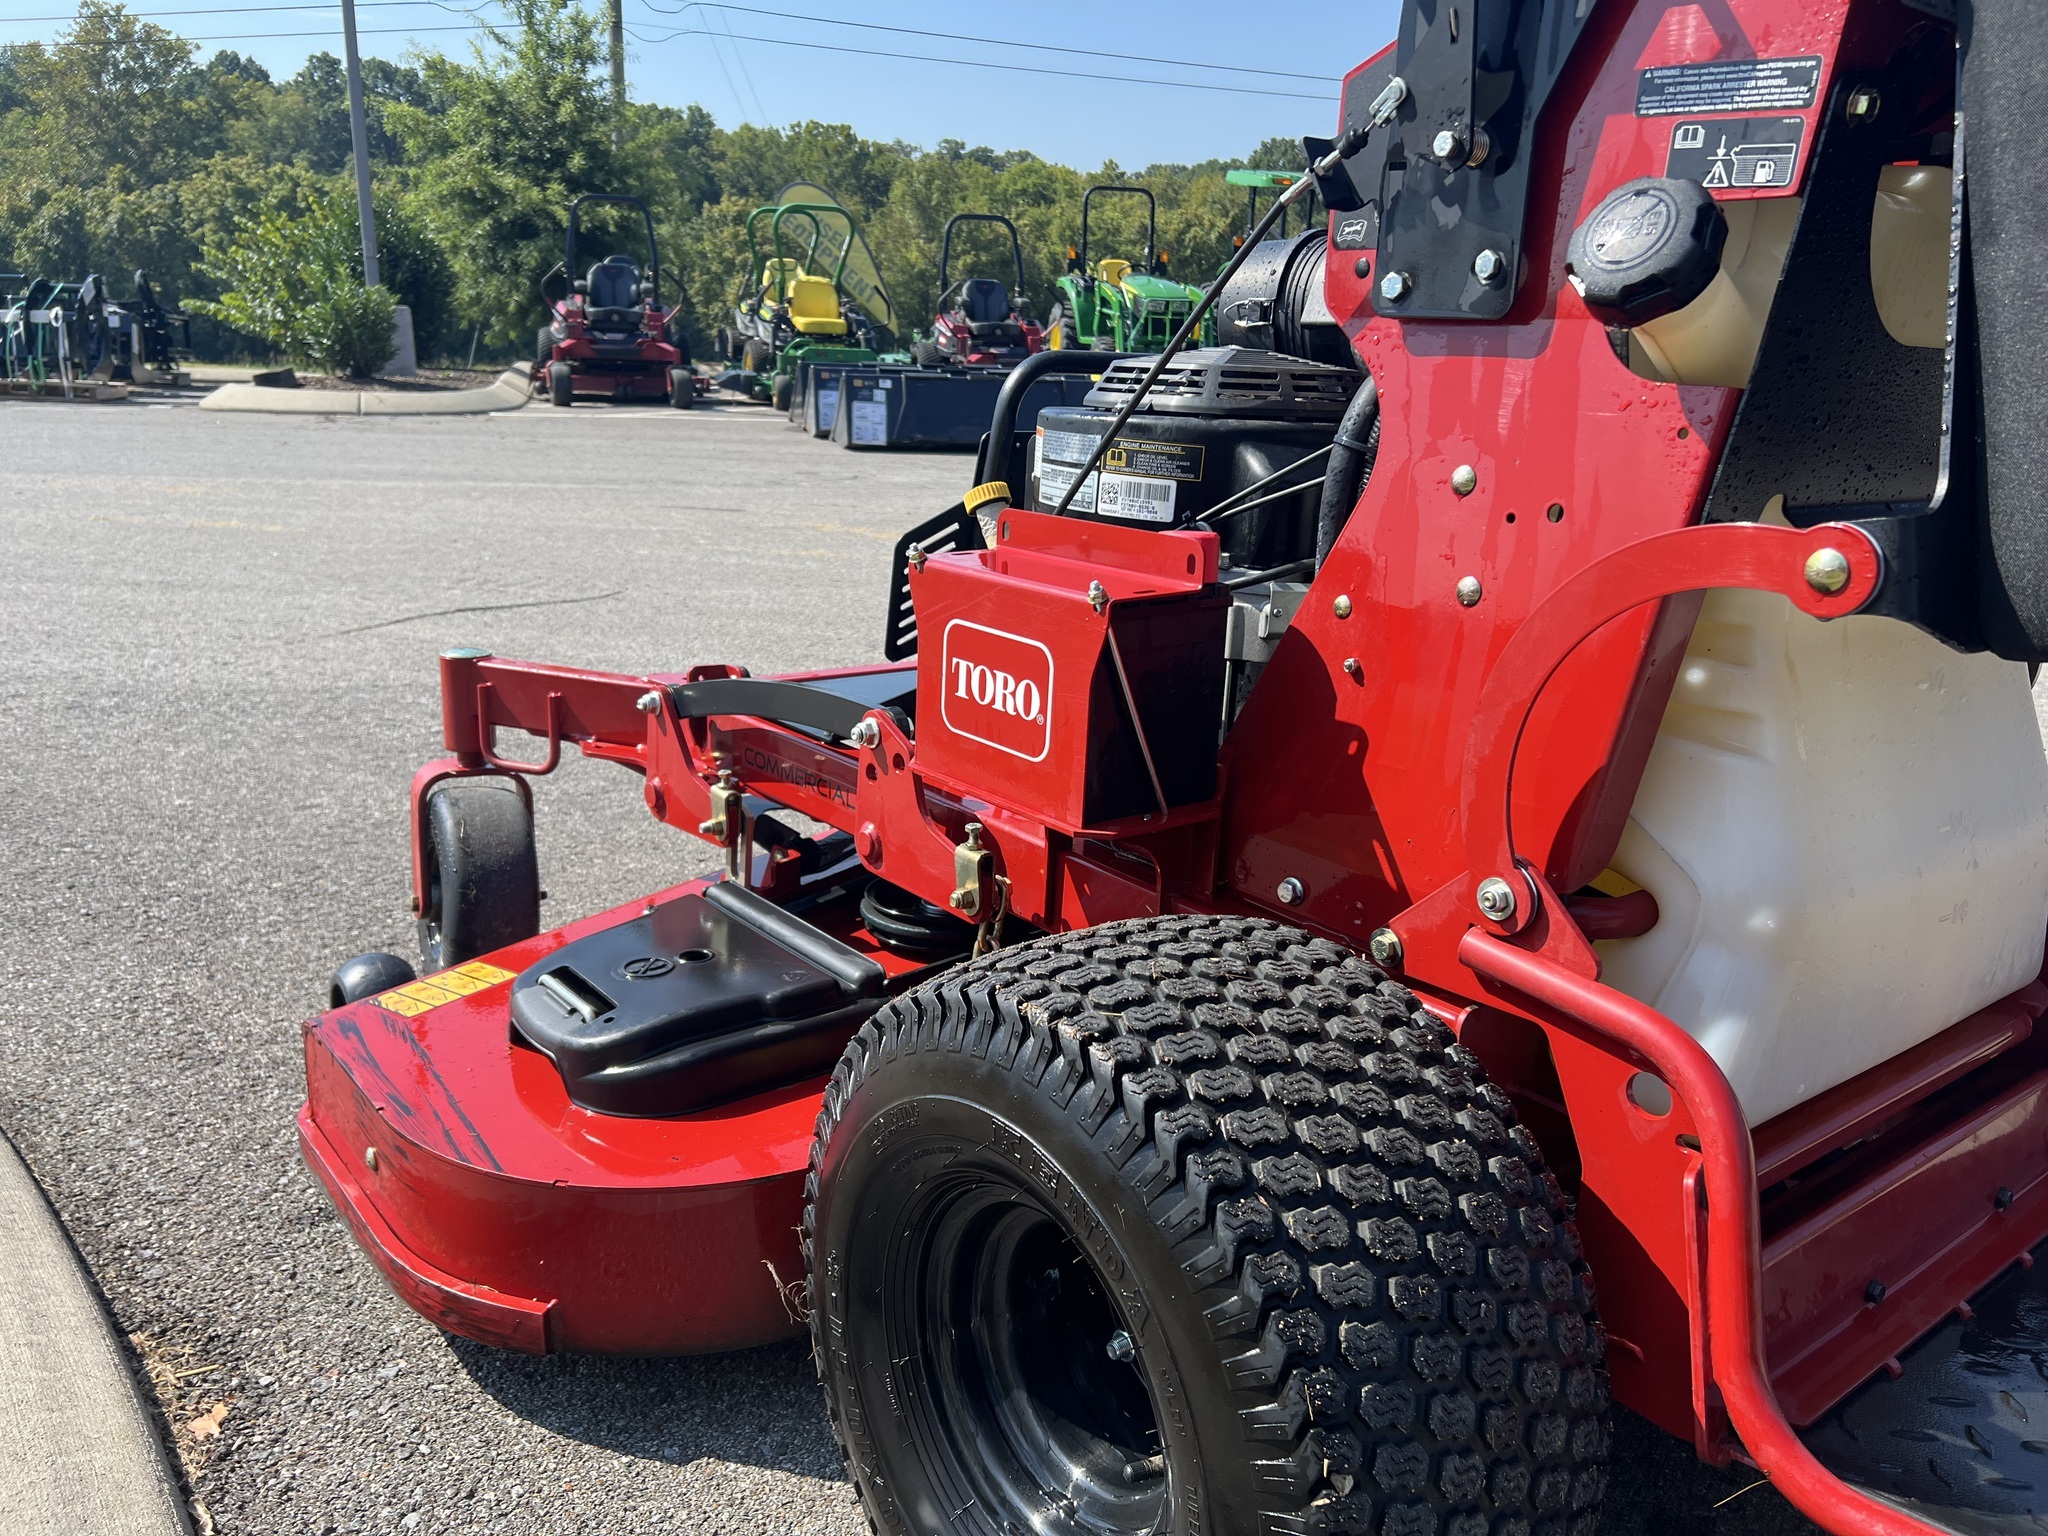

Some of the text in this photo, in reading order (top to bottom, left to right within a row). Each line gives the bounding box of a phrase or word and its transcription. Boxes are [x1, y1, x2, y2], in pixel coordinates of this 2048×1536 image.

[1664, 77, 1788, 93] CALIFORNIA SPARK ARRESTER WARNING
[781, 214, 877, 304] EQUPMENT
[1141, 443, 1182, 452] MAINTENANCE
[951, 656, 1041, 722] TORO
[744, 747, 856, 811] COMMERCIAL
[991, 1117, 1150, 1338] KENDA
[1157, 1367, 1187, 1437] NYLON
